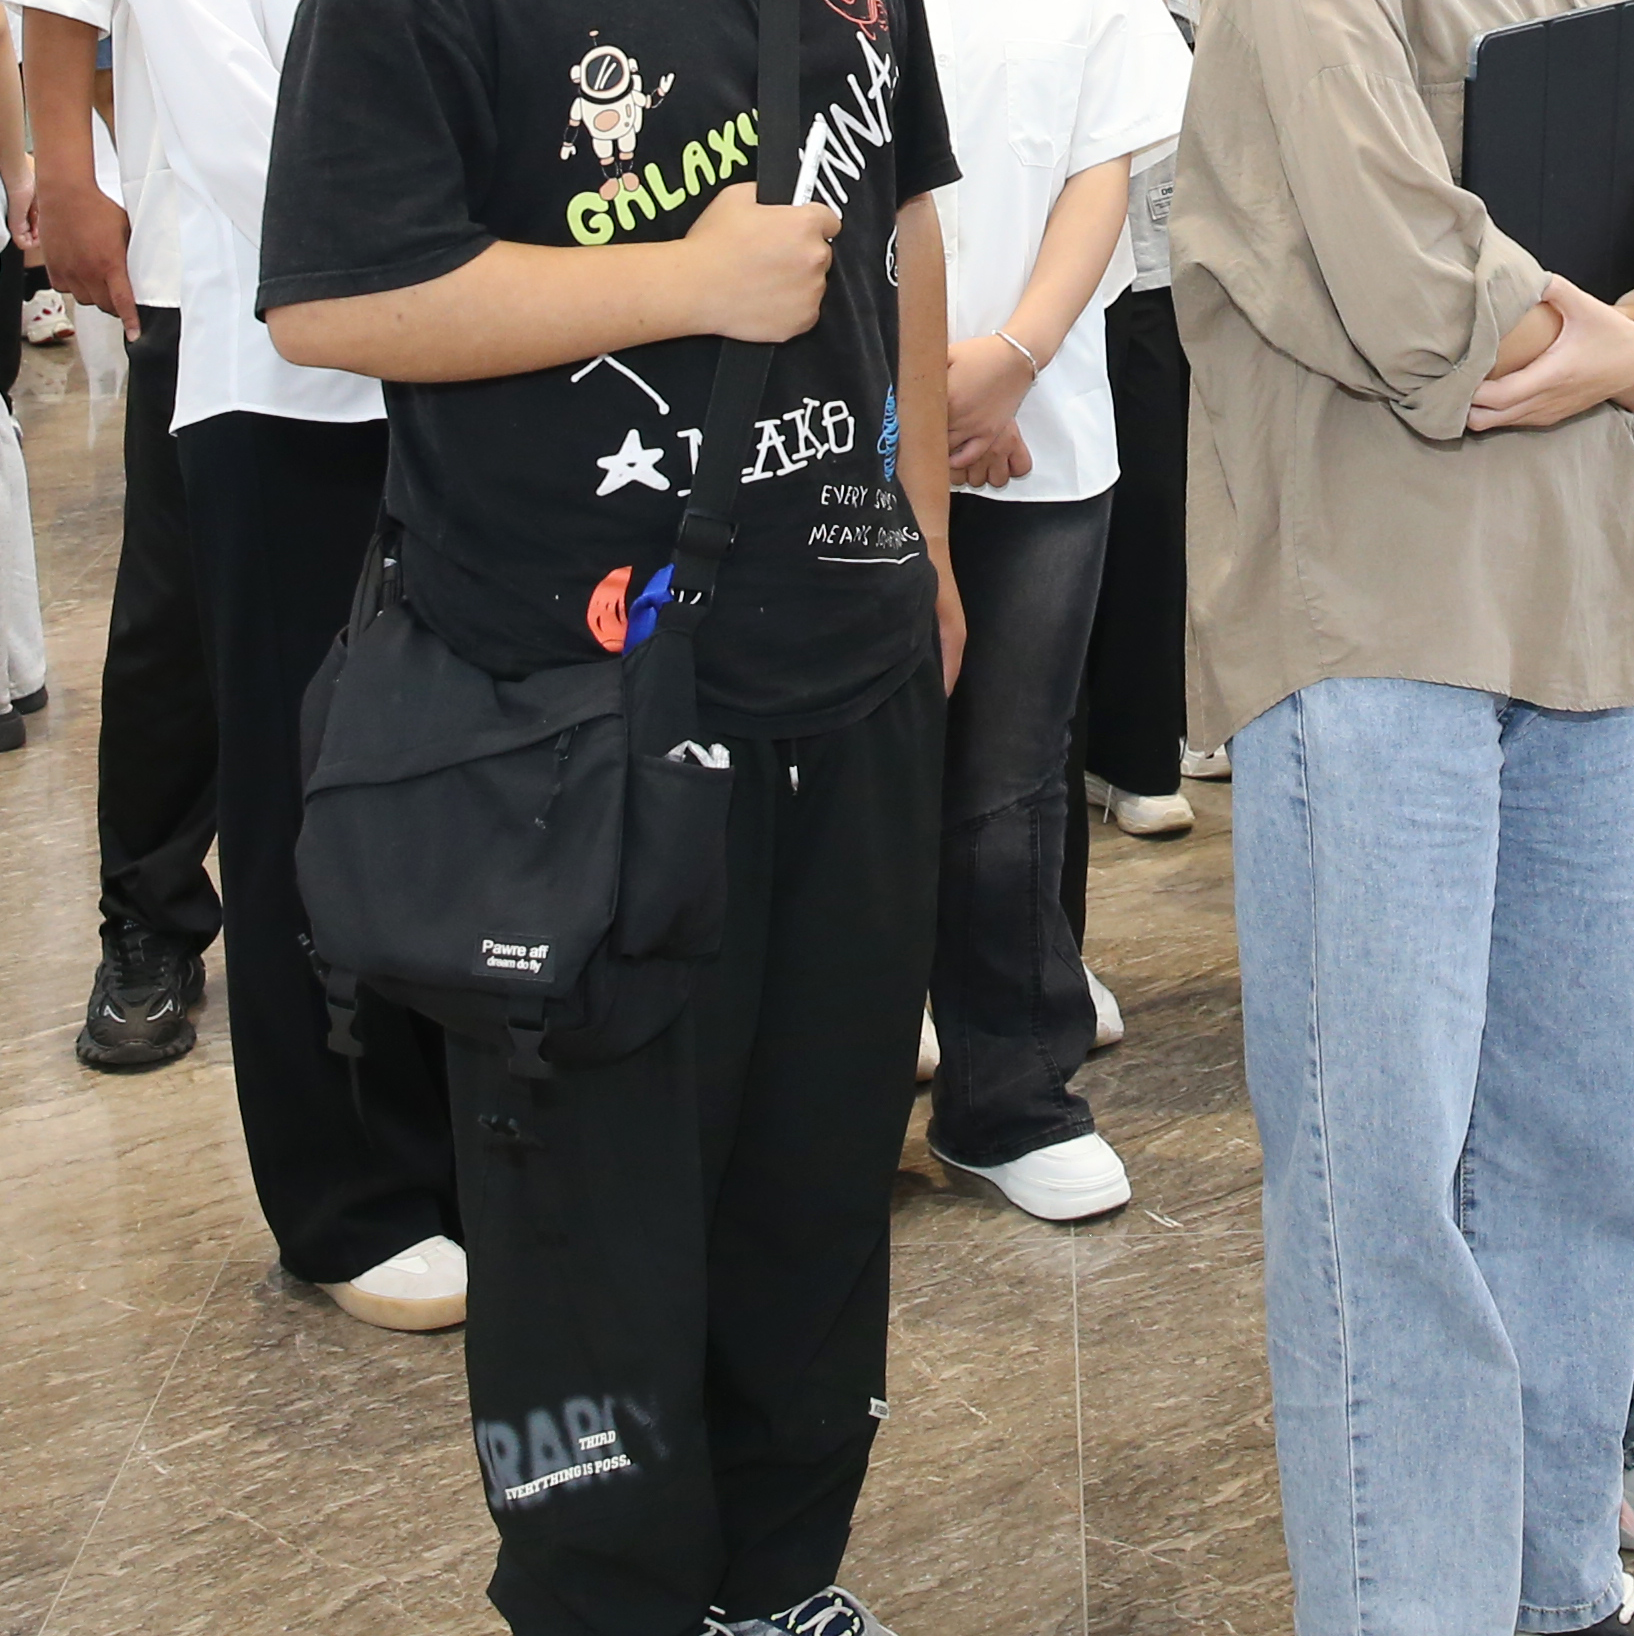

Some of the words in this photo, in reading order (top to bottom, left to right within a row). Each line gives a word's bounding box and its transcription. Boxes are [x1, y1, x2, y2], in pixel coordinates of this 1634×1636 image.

[821, 484, 868, 508] EVERY
[808, 523, 871, 545] MEANS
[579, 1430, 616, 1450] THIRD
